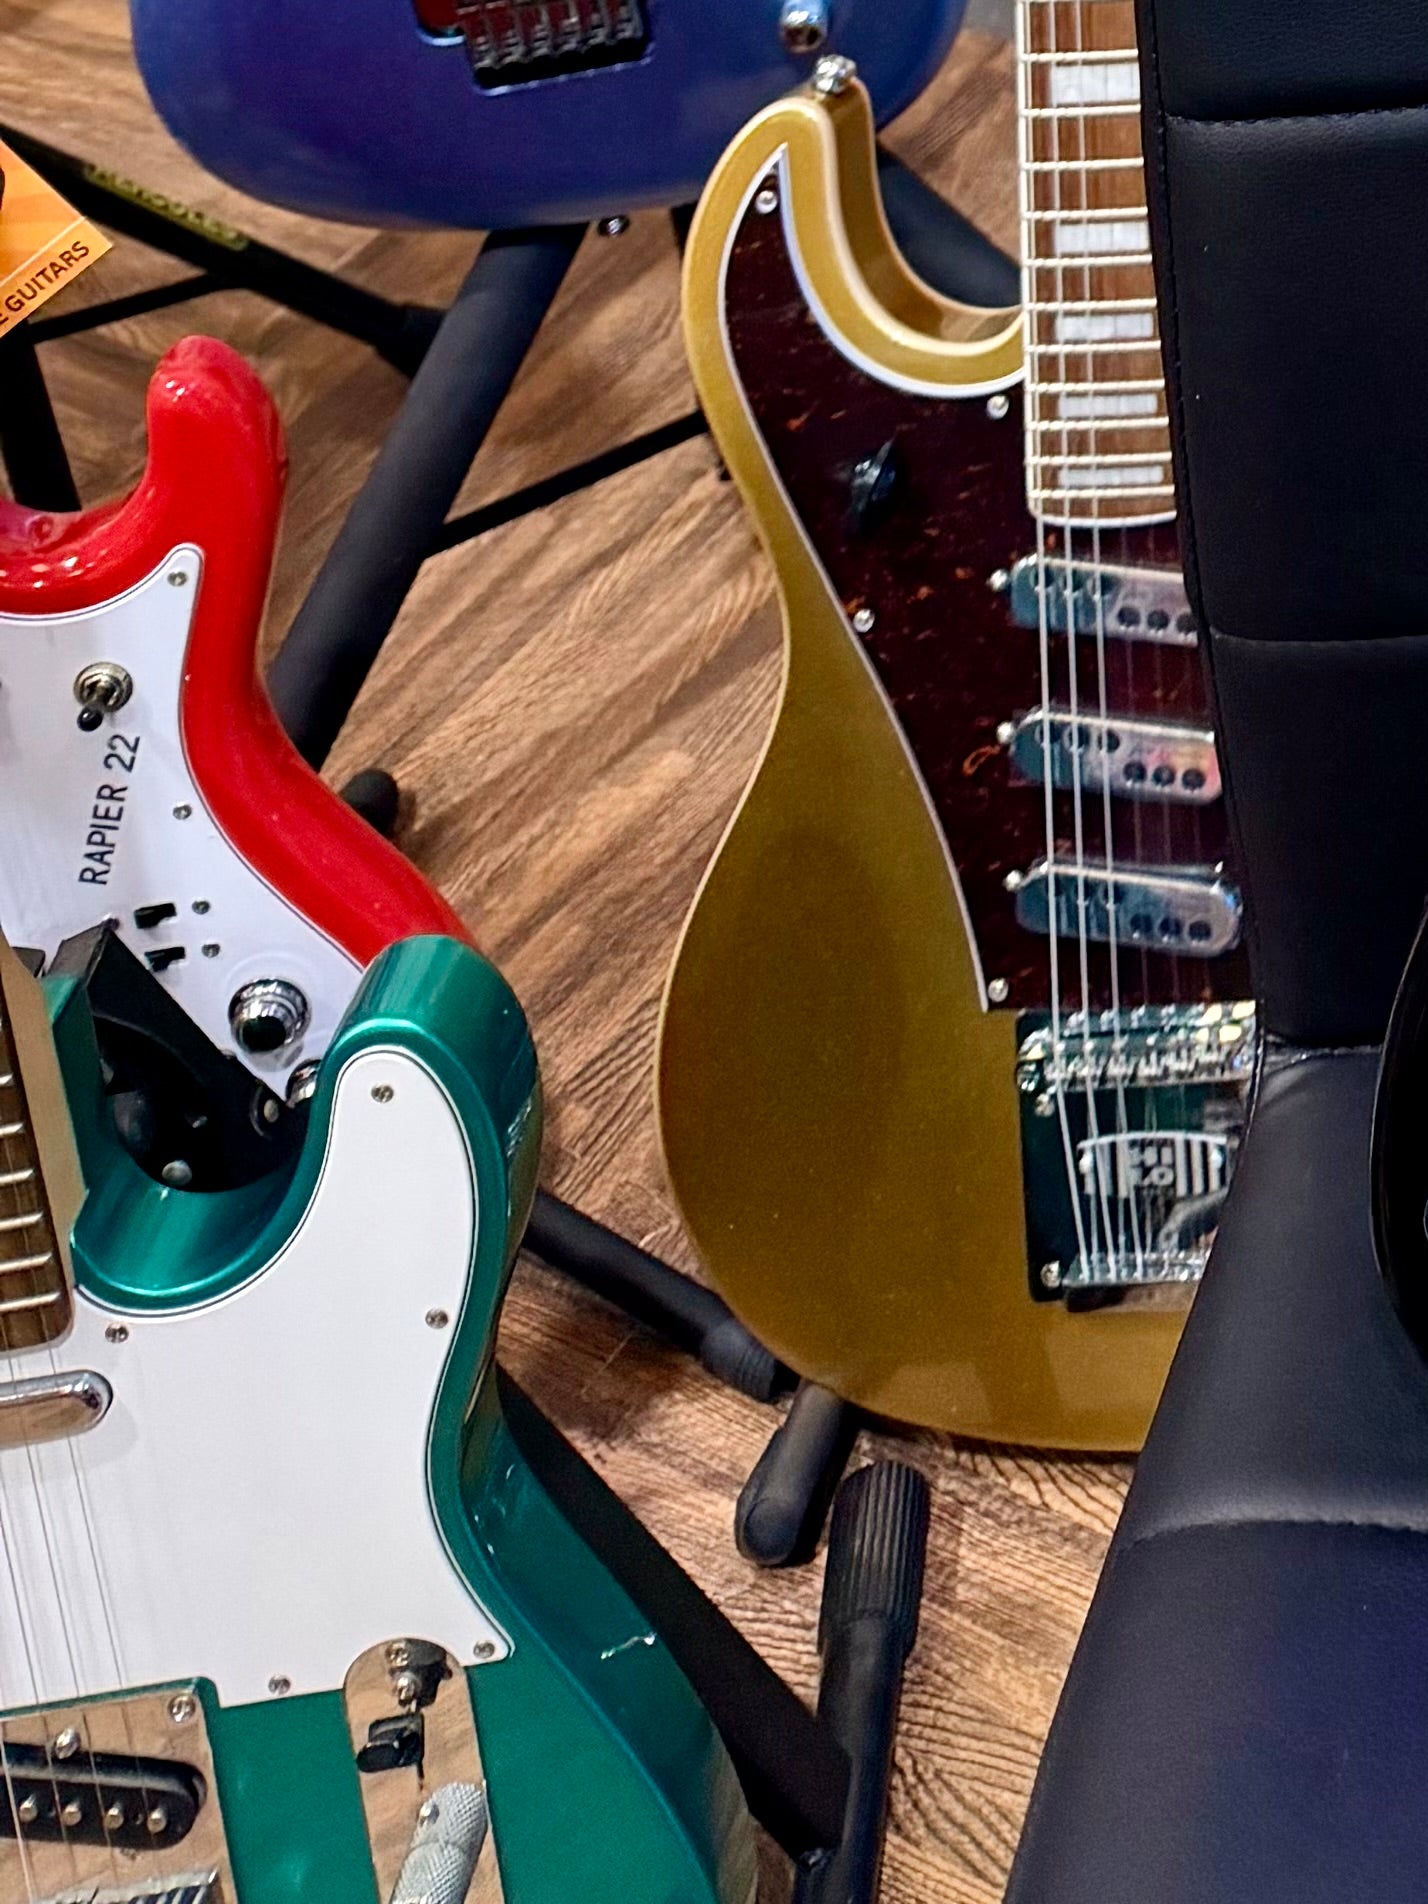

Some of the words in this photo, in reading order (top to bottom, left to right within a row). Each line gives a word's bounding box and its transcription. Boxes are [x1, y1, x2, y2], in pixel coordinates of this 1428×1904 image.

[4, 240, 91, 313] GUITARS
[103, 733, 141, 774] 22
[78, 783, 129, 886] RAPIER
